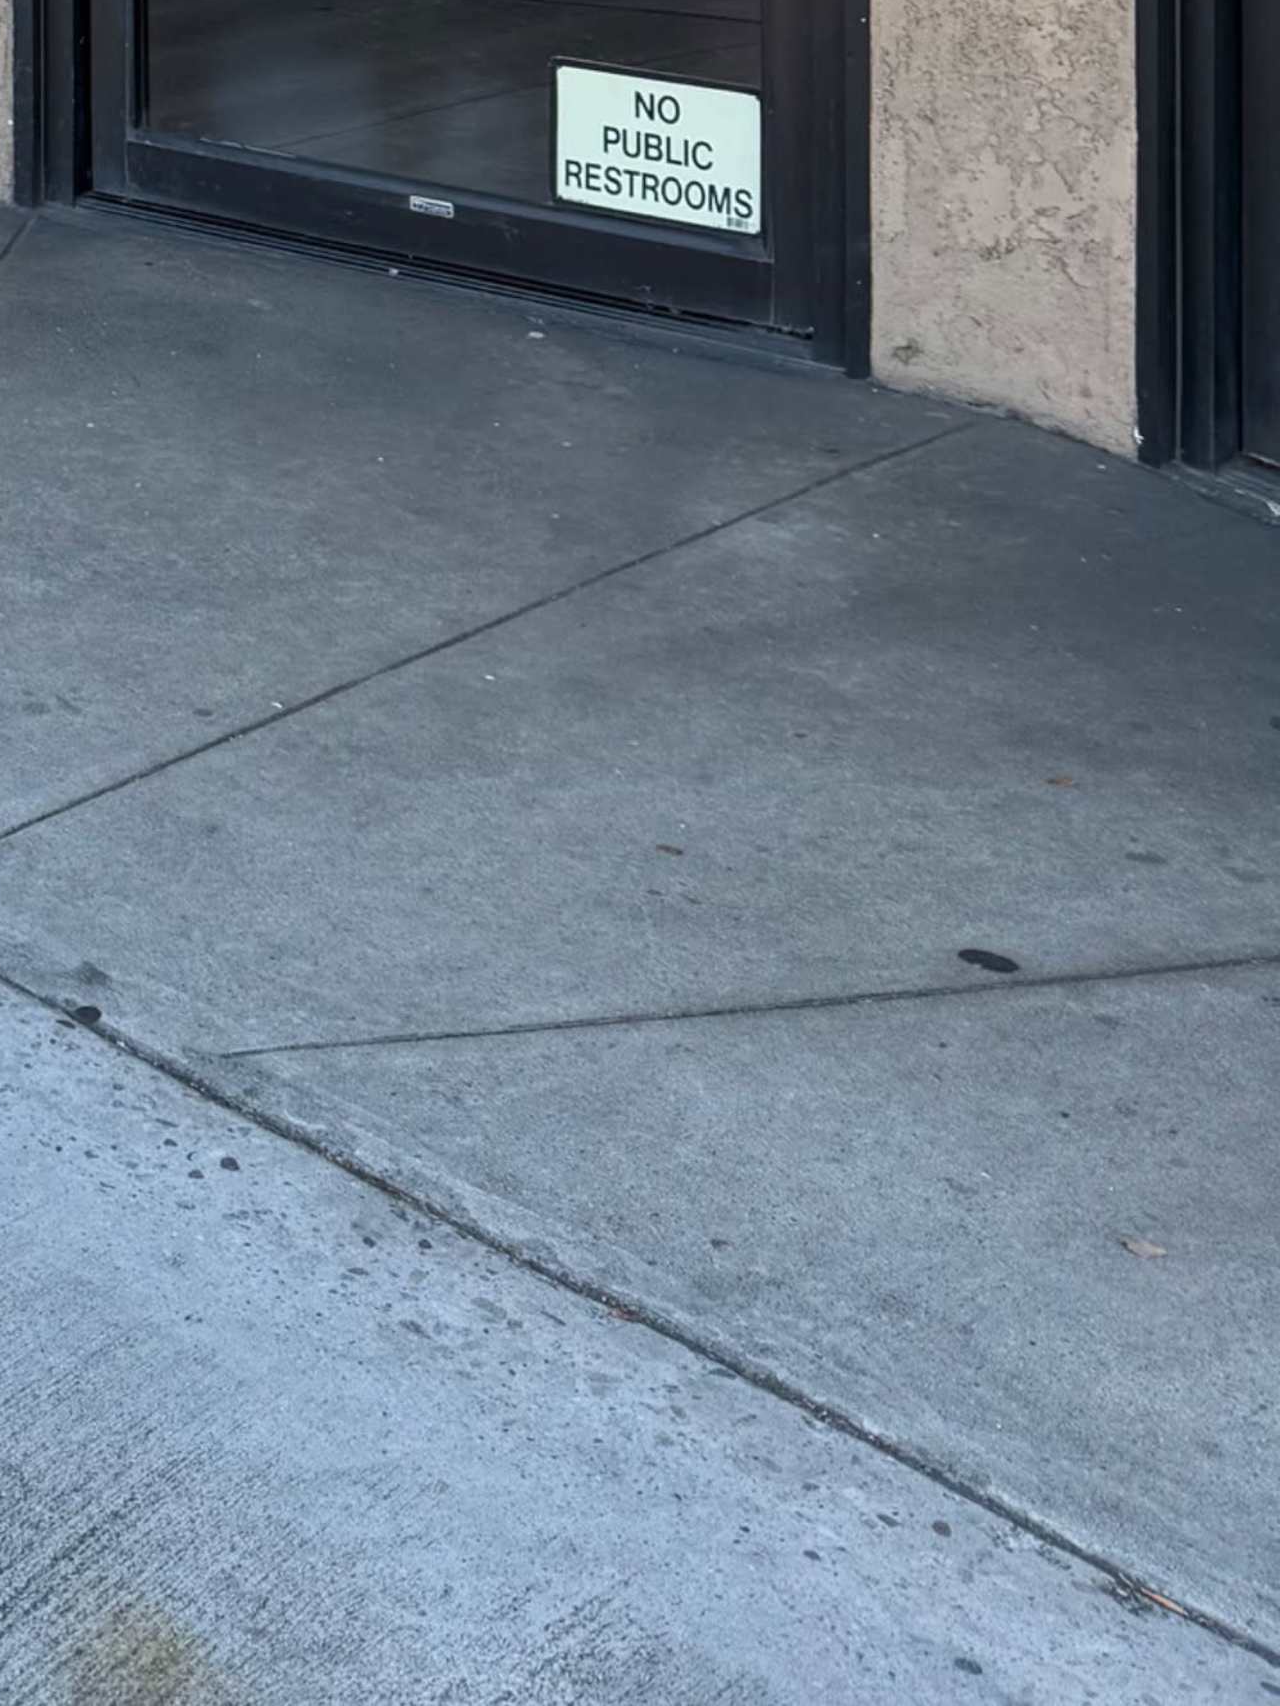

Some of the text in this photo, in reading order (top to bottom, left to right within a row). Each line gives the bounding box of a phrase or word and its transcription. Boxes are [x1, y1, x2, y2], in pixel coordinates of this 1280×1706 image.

[634, 90, 681, 125] NO
[603, 125, 714, 171] PUBLIC
[564, 158, 754, 220] RESTROOMS
